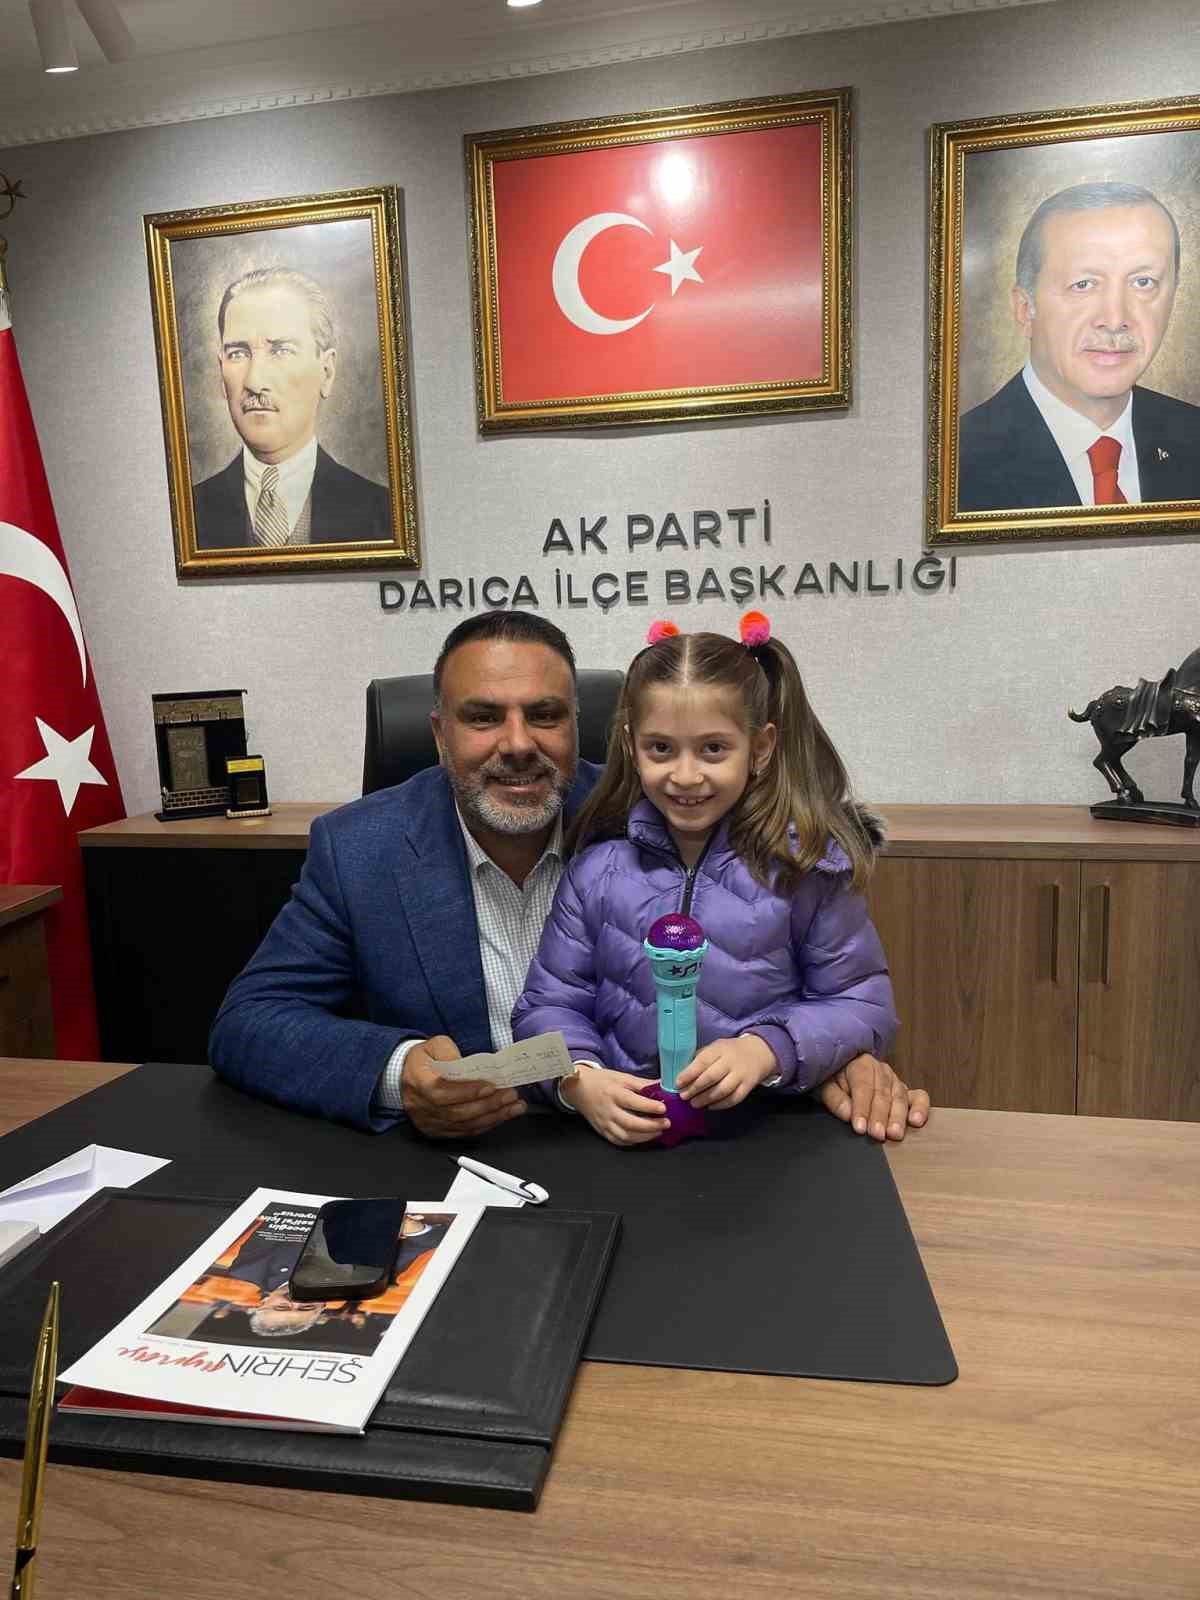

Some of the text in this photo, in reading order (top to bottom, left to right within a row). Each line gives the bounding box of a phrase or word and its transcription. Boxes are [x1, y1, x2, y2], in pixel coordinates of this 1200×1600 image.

[542, 499, 772, 554] AK PARTİ
[379, 549, 958, 614] DARICA İLÇE BAŞKANLIĞI
[220, 1353, 364, 1384] ŞEHRİN
